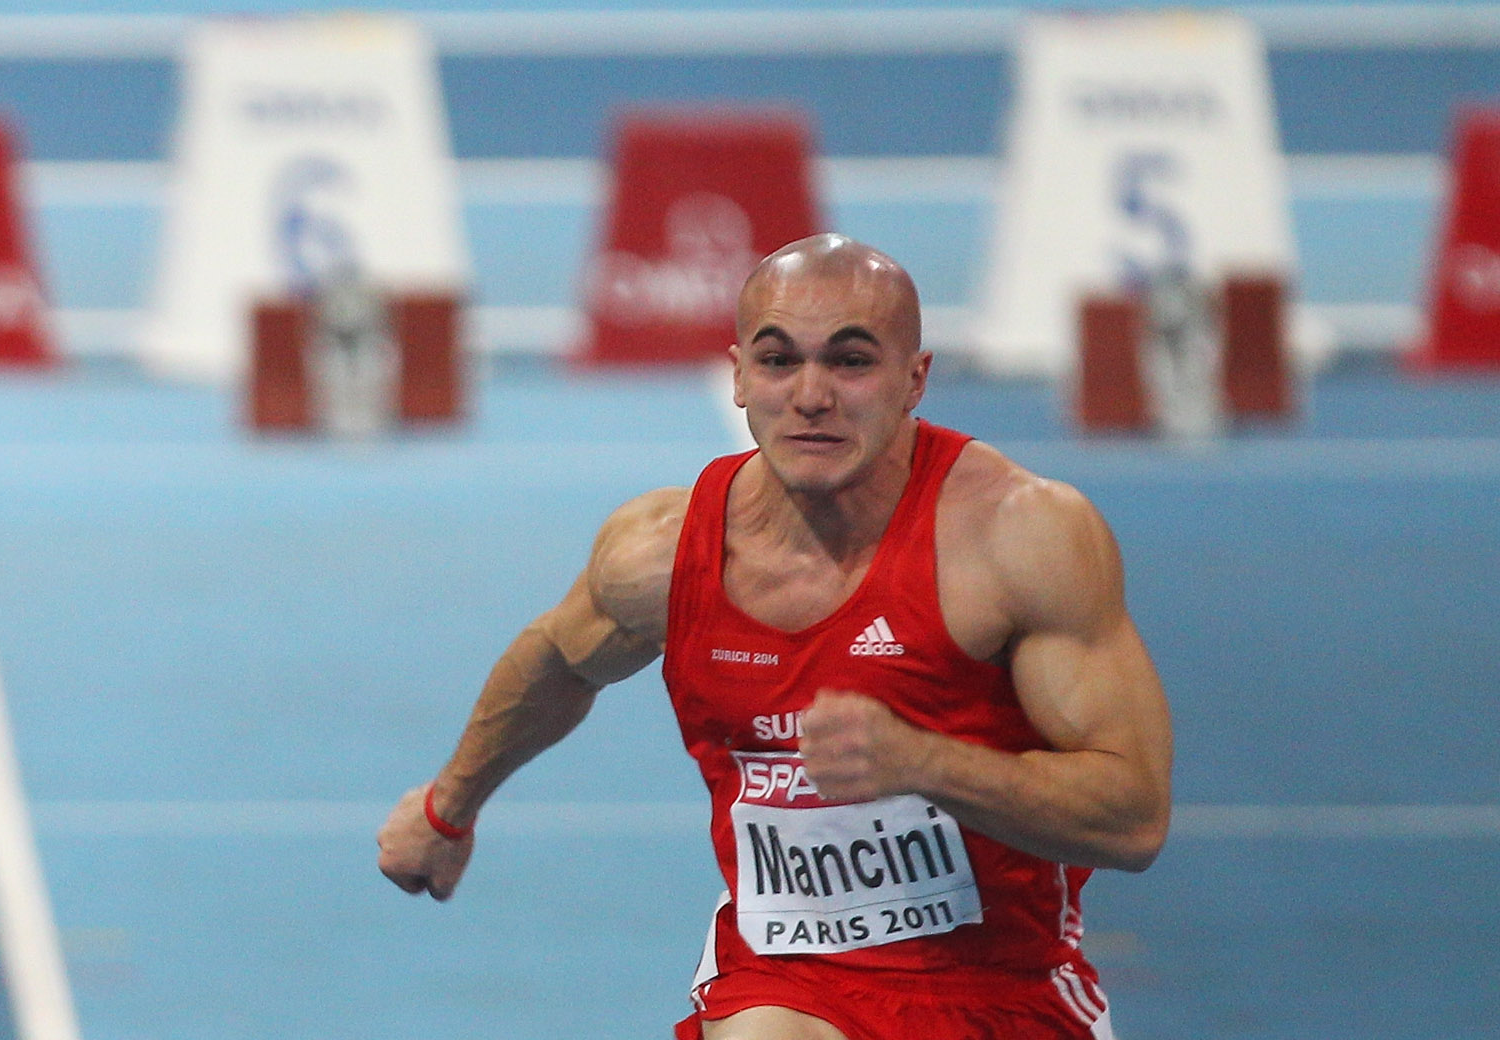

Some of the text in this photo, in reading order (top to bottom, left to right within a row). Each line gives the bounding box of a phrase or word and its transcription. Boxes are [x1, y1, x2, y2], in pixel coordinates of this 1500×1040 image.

[1106, 150, 1194, 298] 5
[752, 651, 779, 665] 2014
[849, 641, 905, 656] adidas
[744, 761, 824, 802] SPA
[747, 805, 955, 898] Mancini
[765, 900, 954, 946] PARIS 2011
